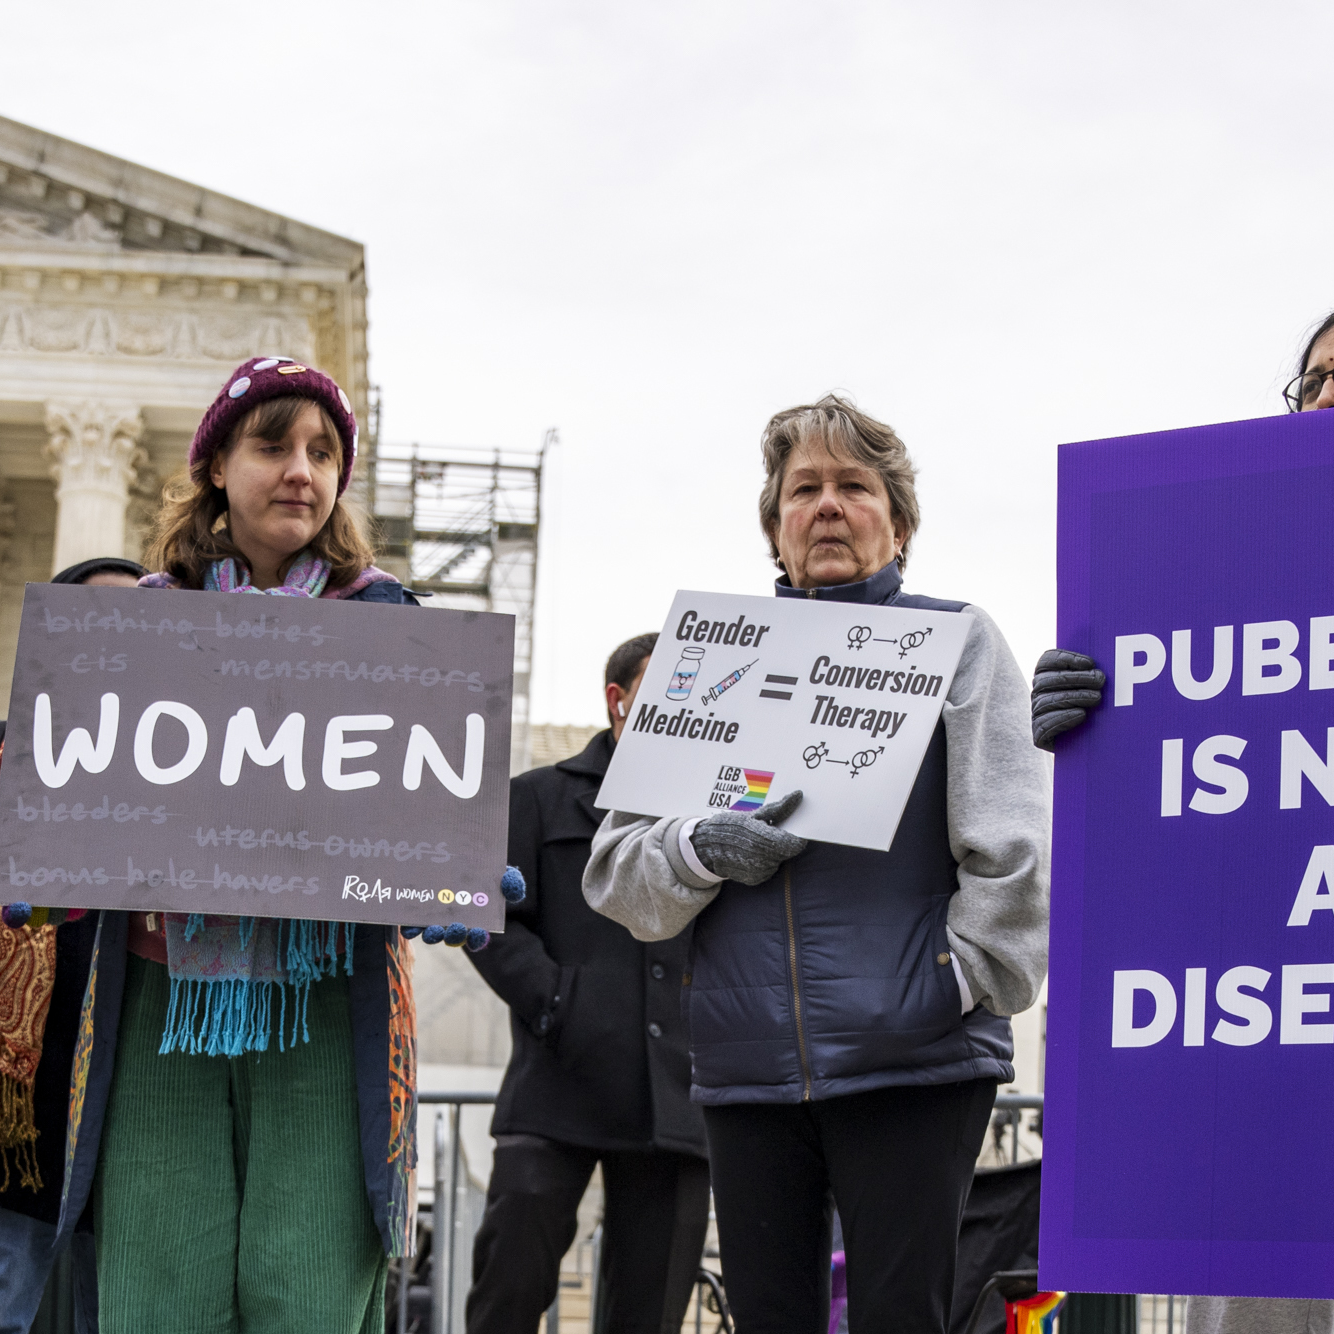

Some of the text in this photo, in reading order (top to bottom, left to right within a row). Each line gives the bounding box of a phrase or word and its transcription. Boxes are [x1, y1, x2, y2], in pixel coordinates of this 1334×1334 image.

[215, 611, 325, 646] bodies
[675, 610, 771, 649] Gender
[69, 646, 129, 674] cis
[220, 654, 486, 692] menstruators
[809, 655, 943, 697] Conversion
[632, 704, 739, 744] Medicine
[809, 695, 908, 739] Therapy
[33, 692, 485, 799] WOMEN
[714, 781, 747, 795] ALLIANCE
[717, 766, 742, 783] LGB
[1161, 735, 1248, 818] IS
[15, 795, 167, 824] bleeders
[708, 792, 732, 809] USA
[196, 825, 452, 863] uterus owners
[127, 857, 198, 890] hole
[396, 889, 435, 903] WOMEN
